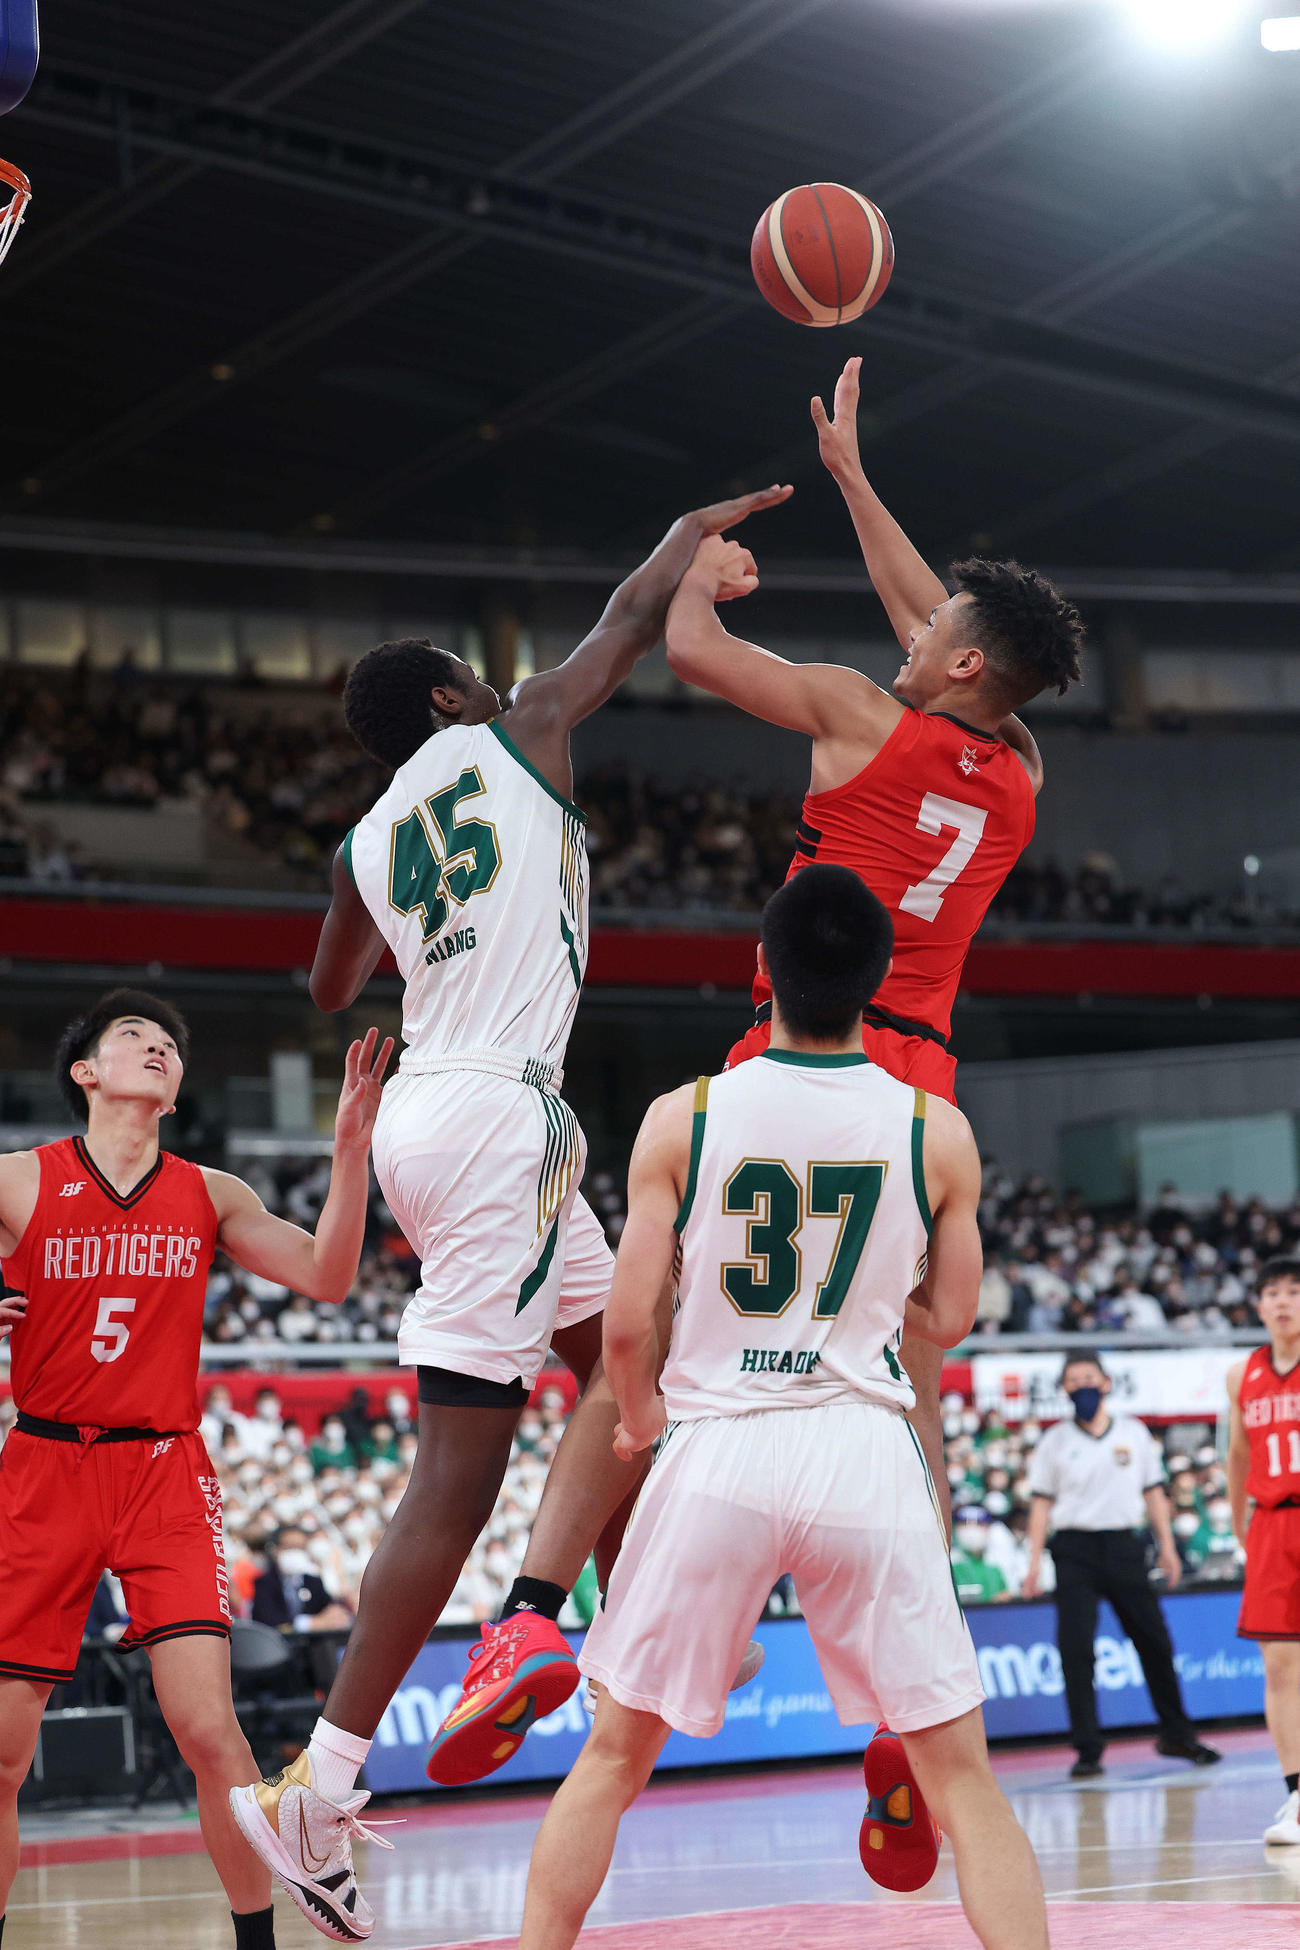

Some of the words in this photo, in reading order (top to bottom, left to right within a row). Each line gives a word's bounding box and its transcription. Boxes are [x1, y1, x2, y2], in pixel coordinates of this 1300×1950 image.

[388, 764, 502, 945] 45
[899, 791, 989, 923] 7
[425, 926, 477, 966] NIANG
[44, 1237, 101, 1279] RED
[105, 1232, 201, 1279] TIGERS
[720, 1157, 889, 1320] 37
[90, 1297, 136, 1363] 5
[1266, 1430, 1300, 1477] 11
